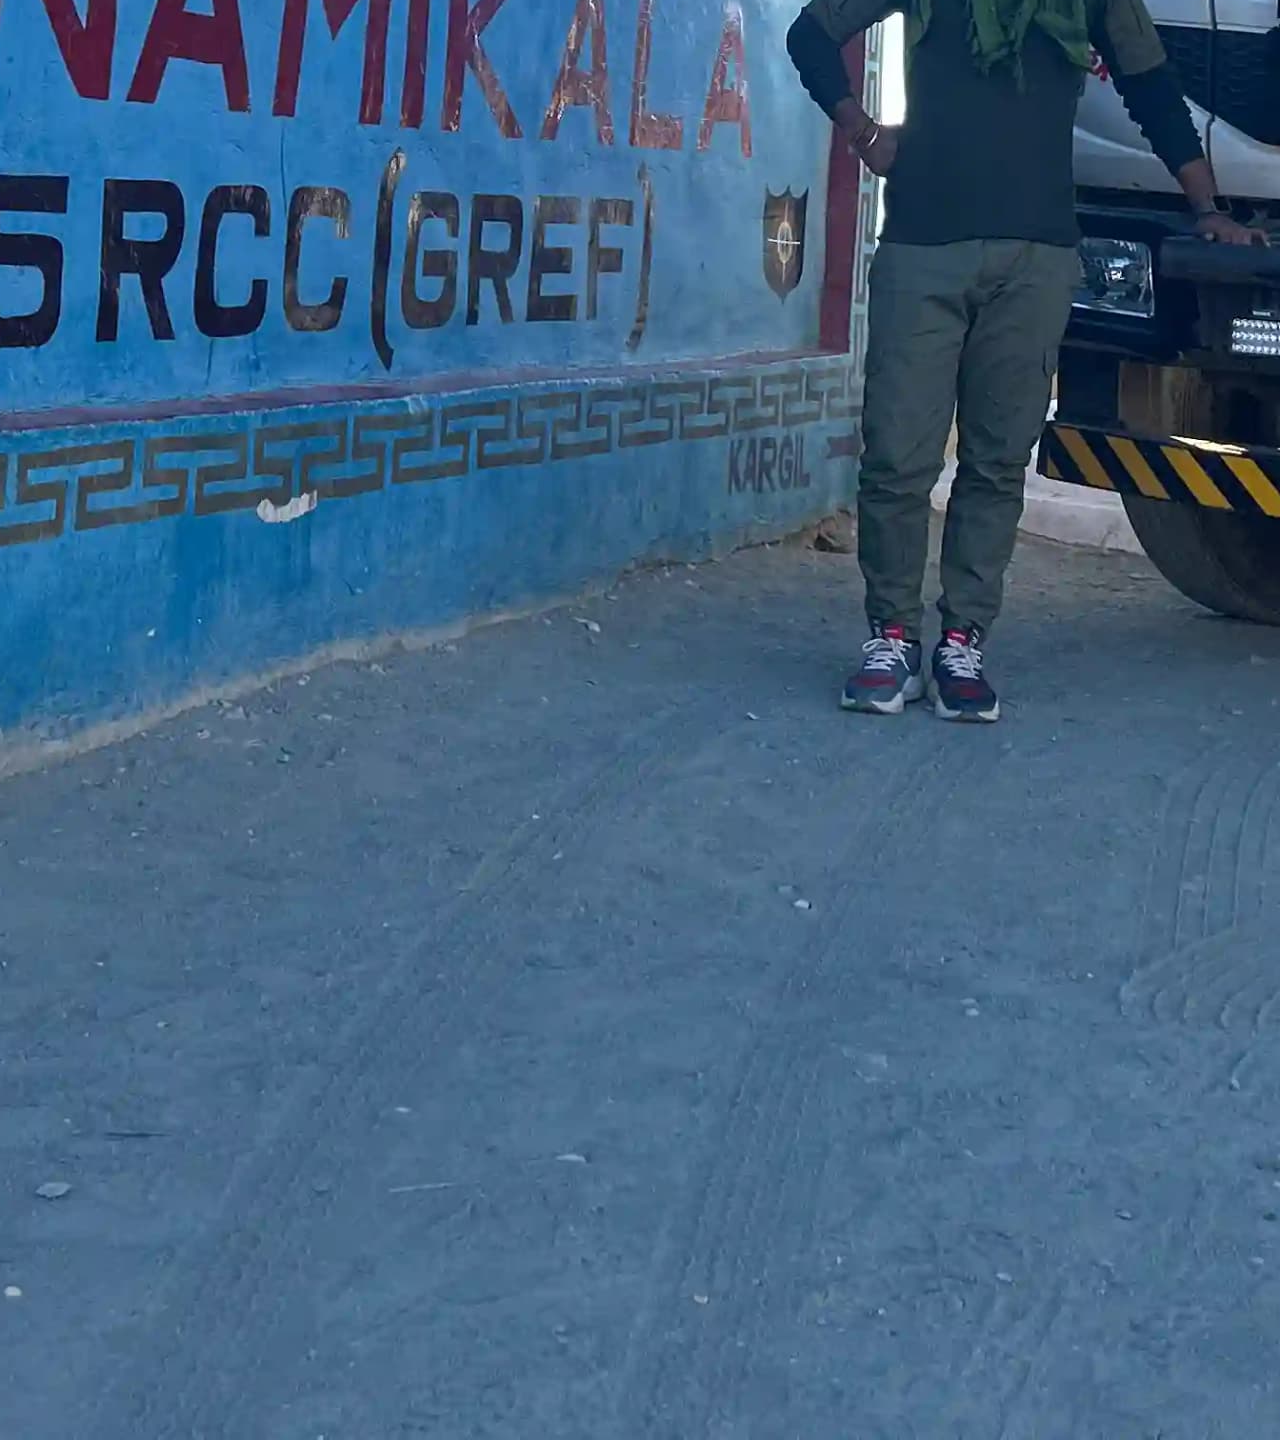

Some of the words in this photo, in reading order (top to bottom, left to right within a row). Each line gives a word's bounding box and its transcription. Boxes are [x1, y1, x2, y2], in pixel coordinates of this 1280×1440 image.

[94, 177, 353, 343] RCC
[371, 146, 655, 371] (GREF)
[727, 434, 811, 496] KARGIL
